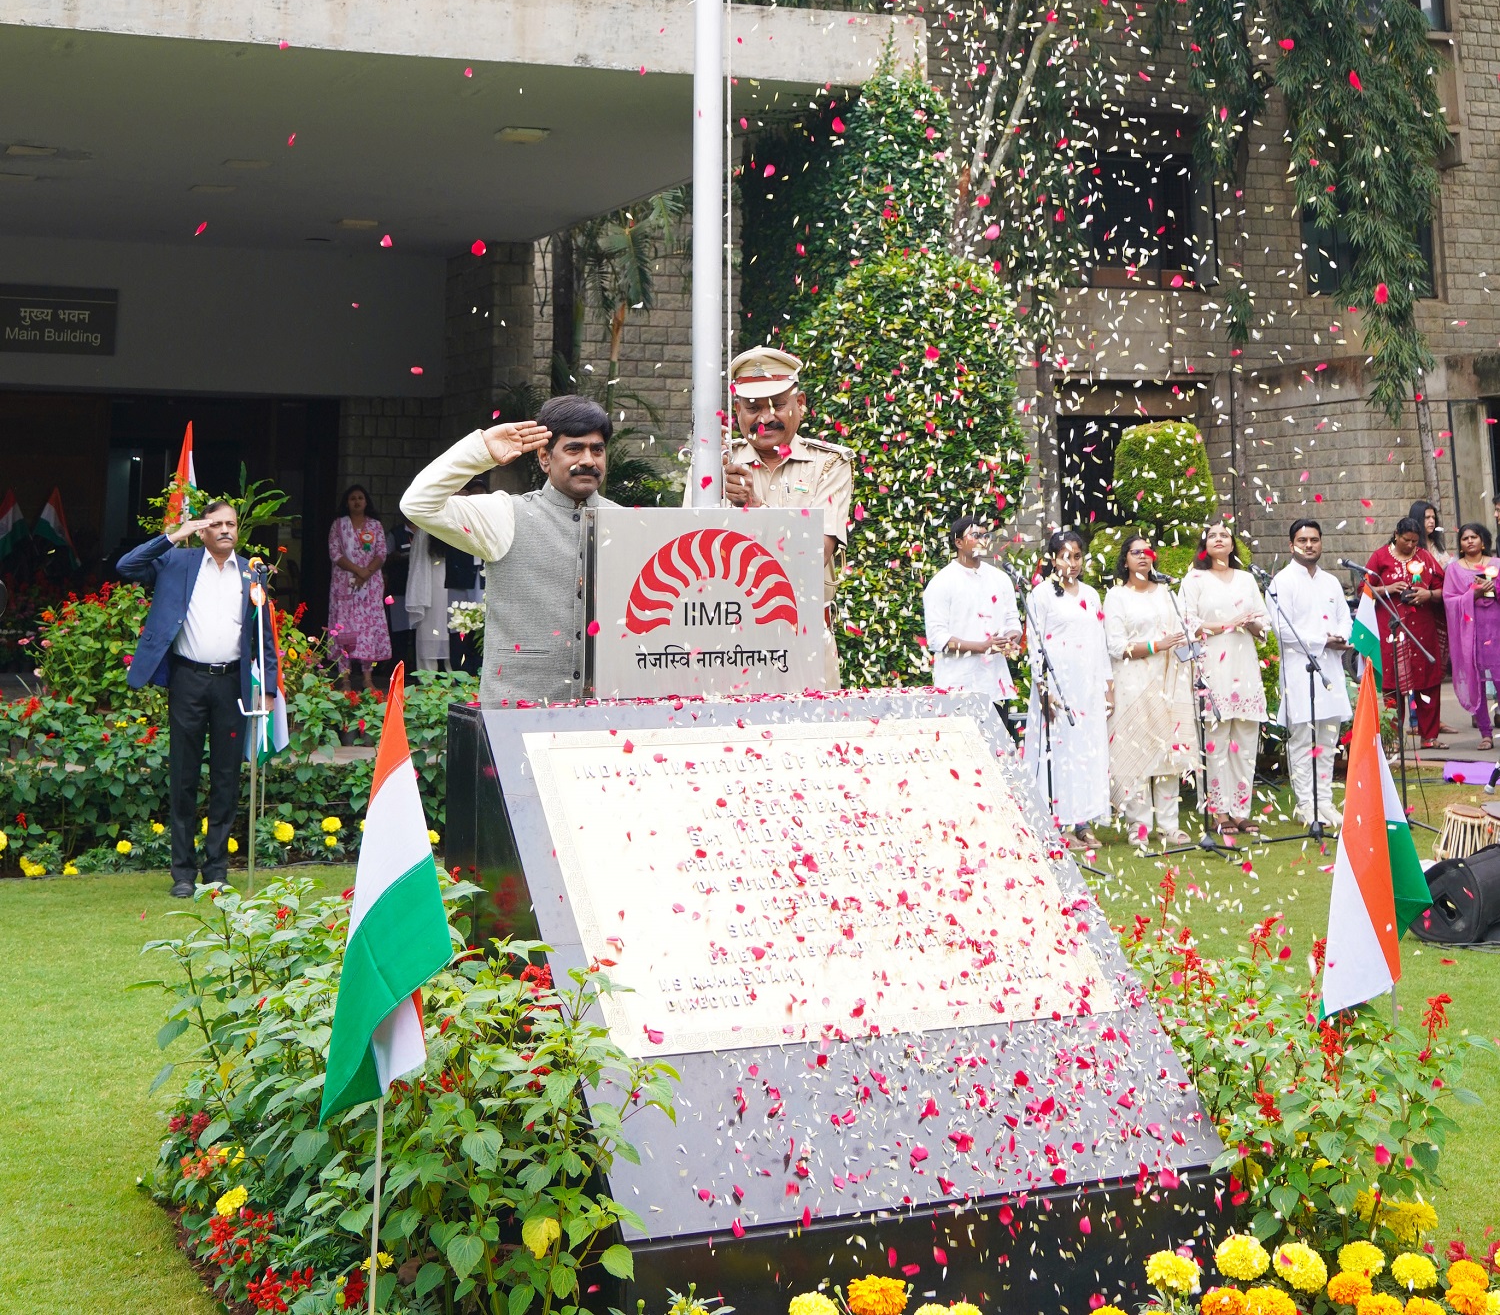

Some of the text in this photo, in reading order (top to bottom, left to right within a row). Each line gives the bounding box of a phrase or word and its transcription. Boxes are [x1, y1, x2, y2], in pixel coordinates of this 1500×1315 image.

[20, 308, 91, 325] मुख्य भवन
[5, 327, 101, 346] Main Building
[684, 601, 742, 626] IIMB
[635, 644, 691, 669] तेजस्वि
[573, 749, 954, 780] INDIAN INSTITUTE OF MANAGEMENT
[723, 777, 835, 795] BANGALORE
[703, 796, 869, 820] INAUGURATED BY
[735, 822, 816, 845] INDIRA
[821, 818, 904, 840] GANDHI
[684, 856, 744, 872] PRIME
[749, 850, 839, 870] MINISER
[727, 921, 760, 938] SRI
[900, 908, 937, 924] URS
[689, 968, 804, 991] RAMASWAMY
[666, 991, 754, 1013] DIRECTOR
